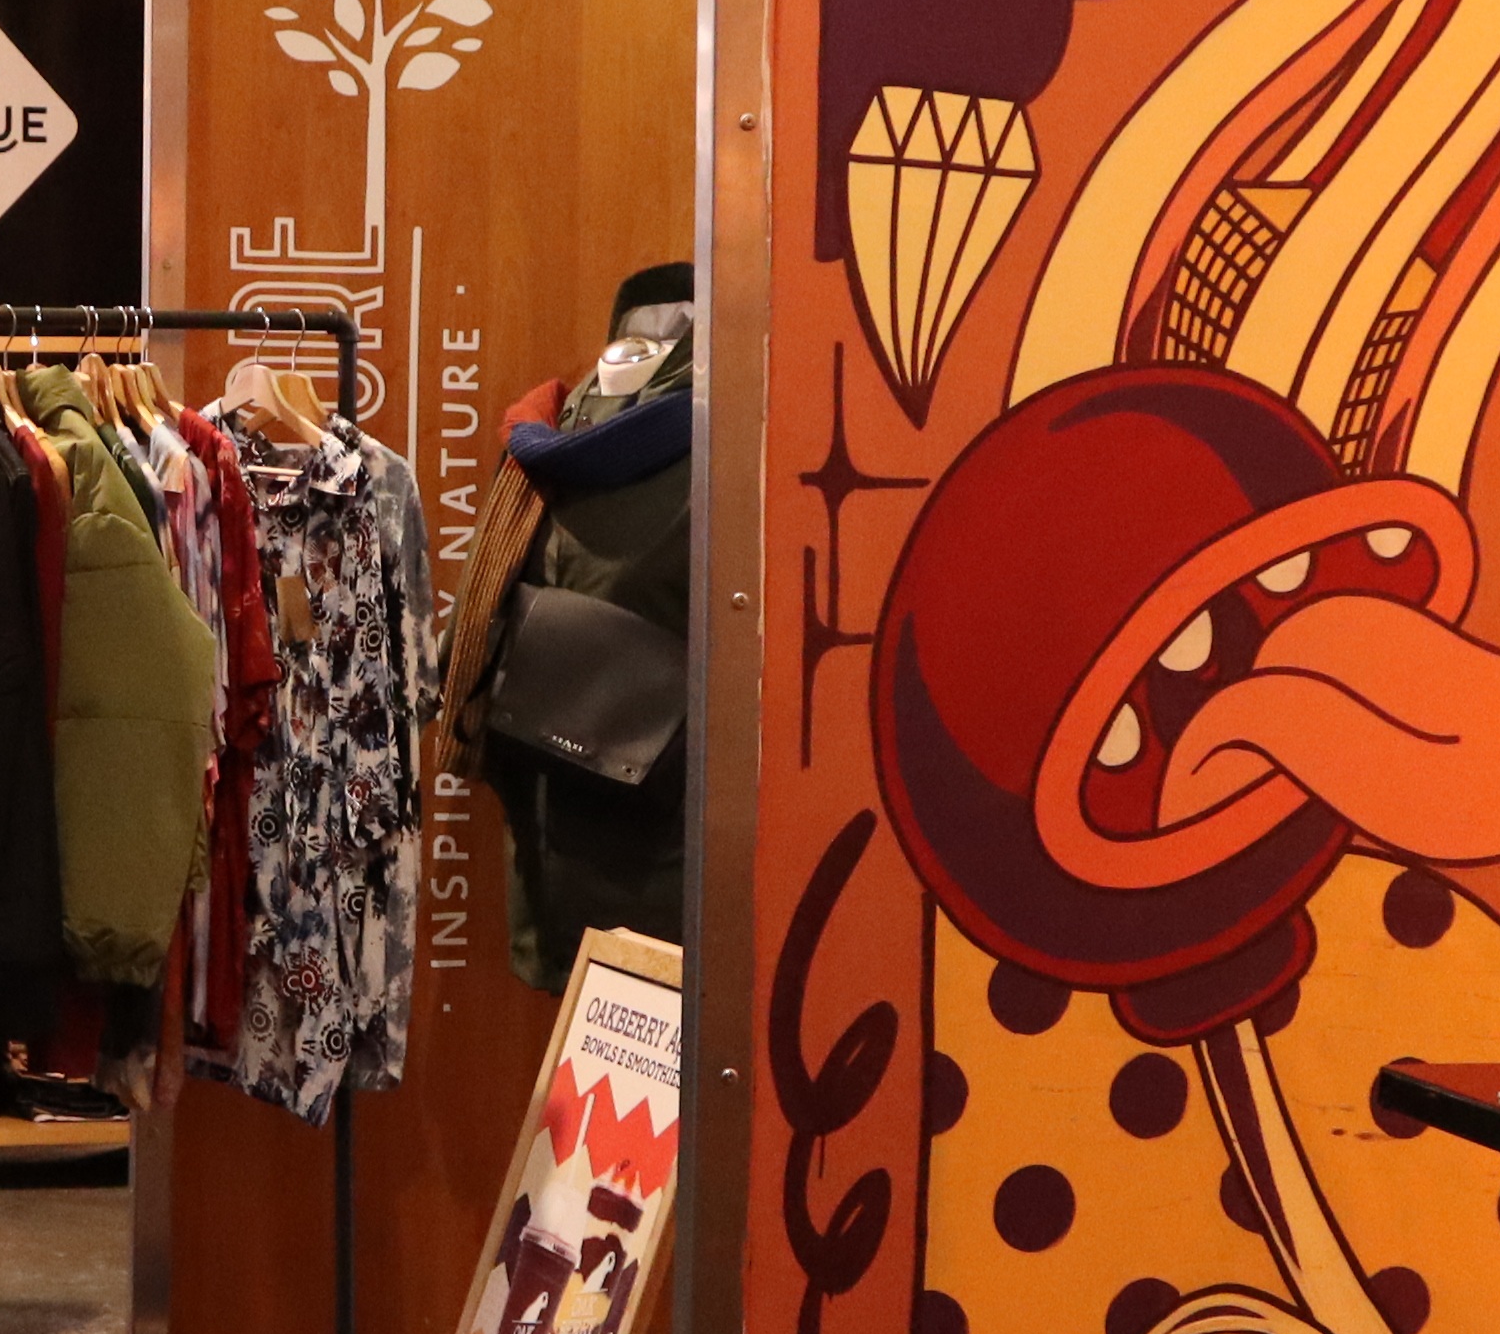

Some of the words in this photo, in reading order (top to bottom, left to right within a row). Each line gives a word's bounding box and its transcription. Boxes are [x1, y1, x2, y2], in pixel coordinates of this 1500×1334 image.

[438, 327, 481, 561] NATURE
[586, 996, 670, 1048] OAKBERRY
[581, 1034, 619, 1063] BOWLS
[617, 1048, 628, 1066] E
